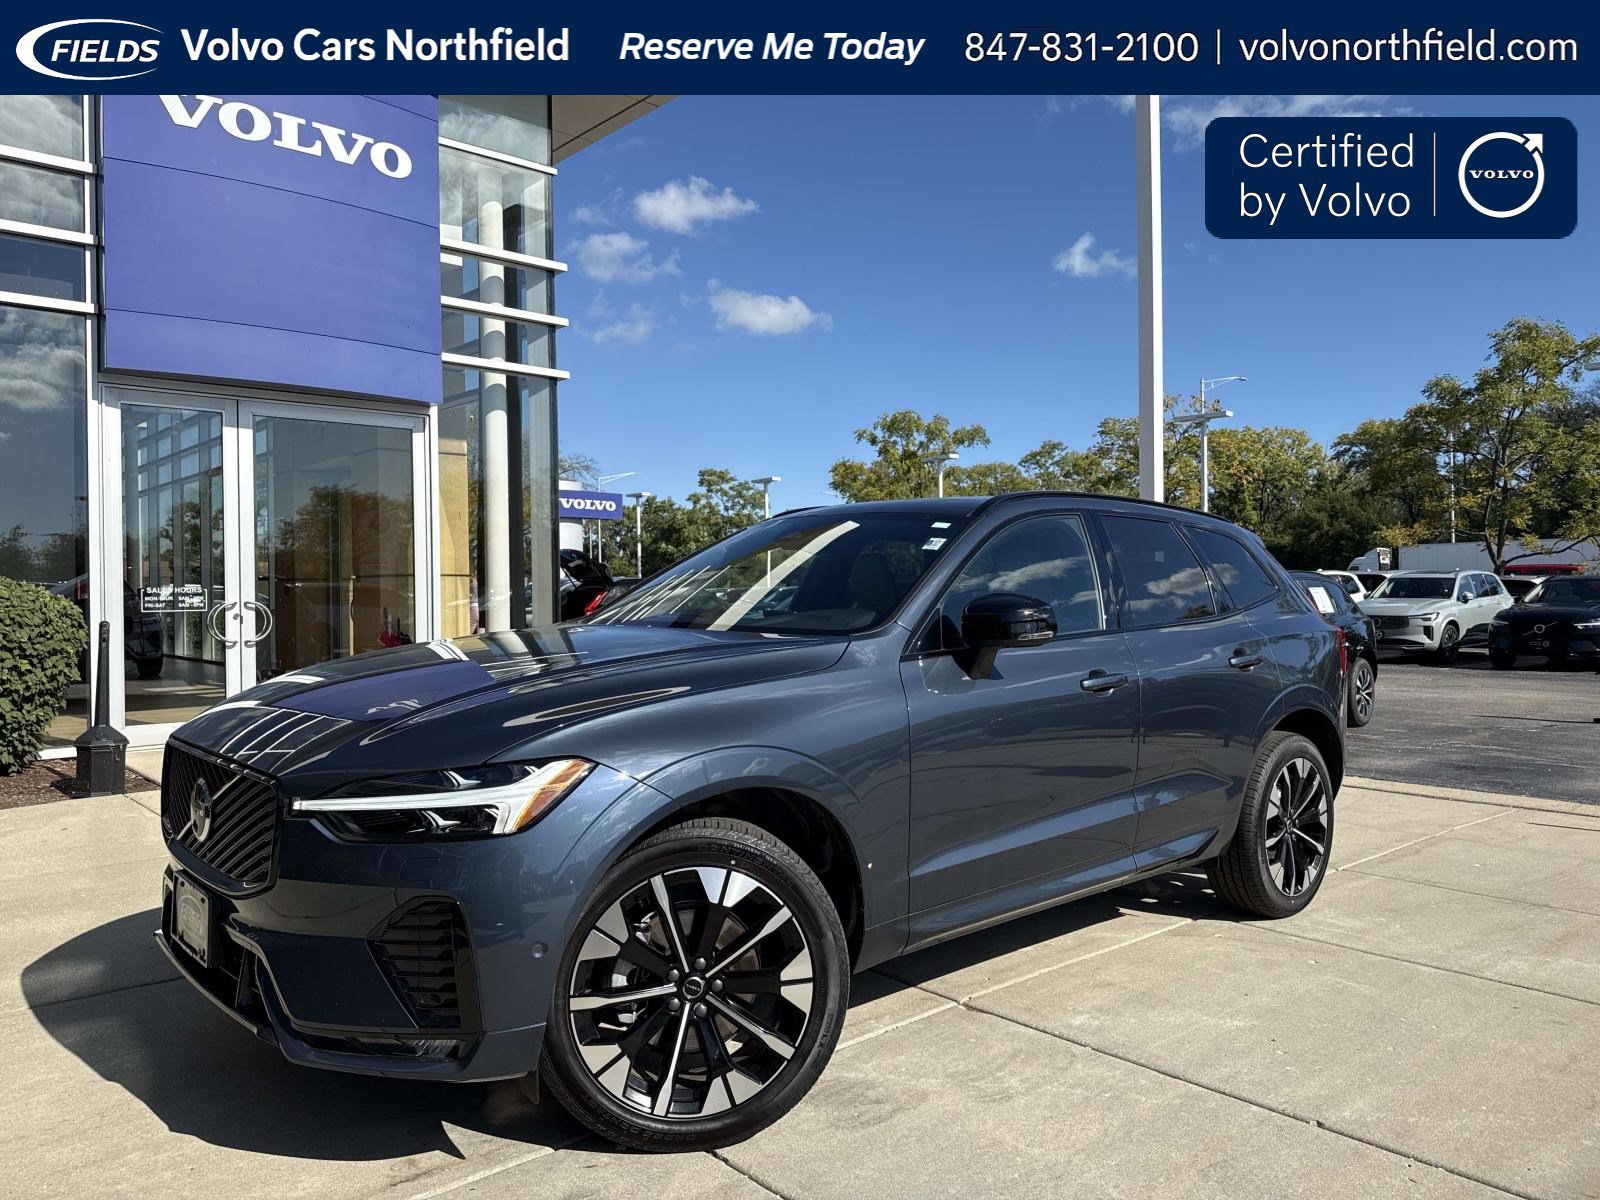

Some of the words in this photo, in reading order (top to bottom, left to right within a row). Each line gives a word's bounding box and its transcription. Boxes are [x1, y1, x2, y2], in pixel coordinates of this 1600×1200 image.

[159, 95, 413, 179] VOLVO
[559, 497, 617, 512] VOLVO
[174, 586, 202, 594] HOURS
